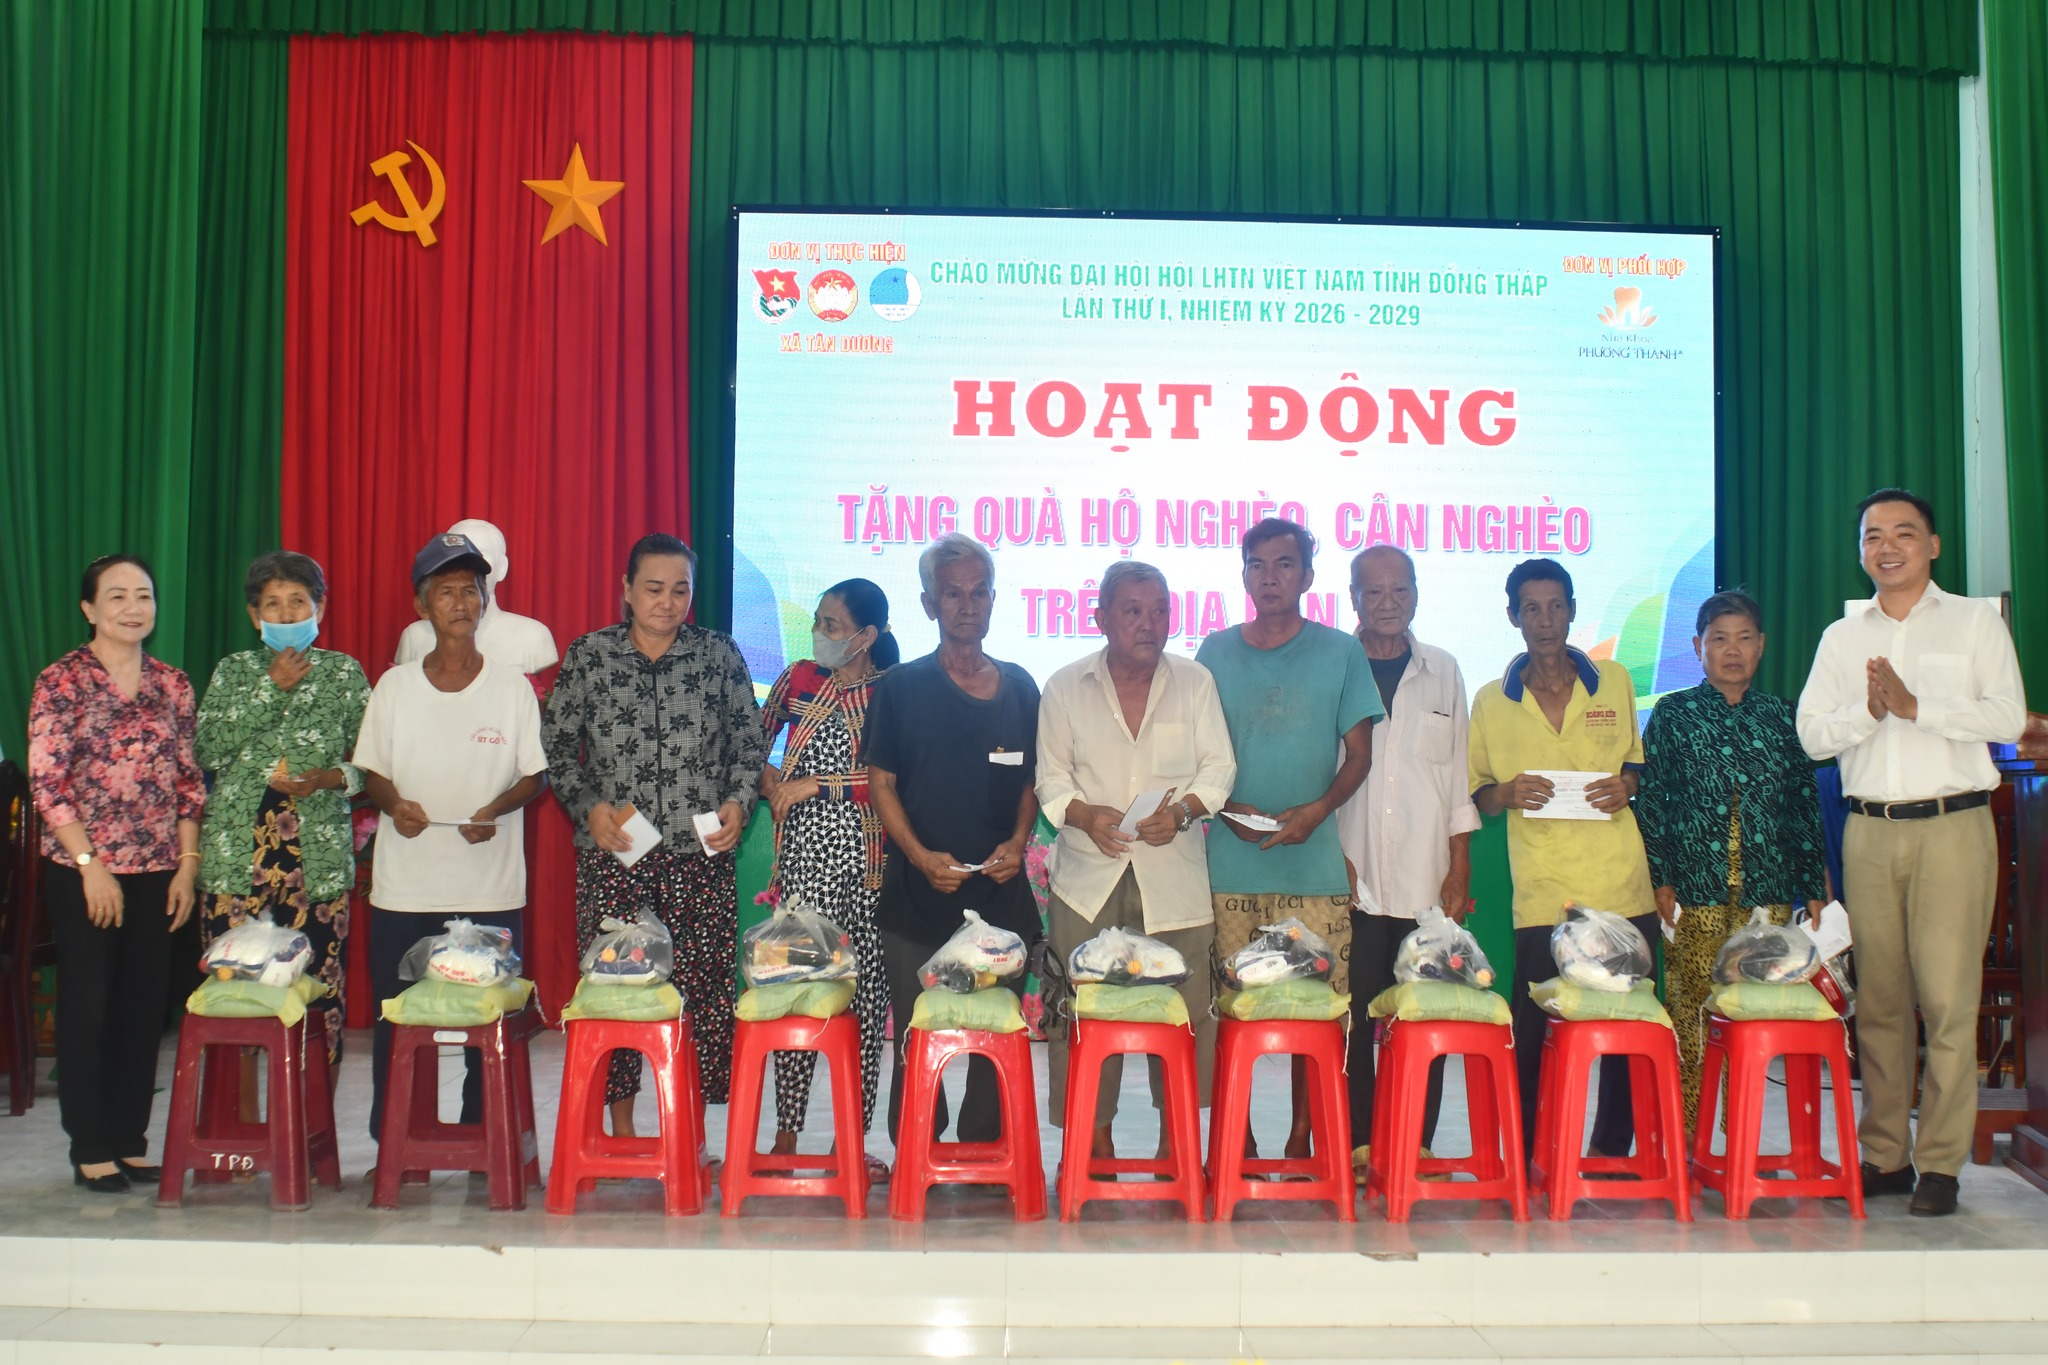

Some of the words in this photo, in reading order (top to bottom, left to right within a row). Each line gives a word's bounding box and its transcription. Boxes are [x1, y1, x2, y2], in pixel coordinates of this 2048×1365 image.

[768, 241, 801, 260] ĐƠN
[806, 243, 820, 264] VỊ
[825, 242, 865, 264] THỰC
[869, 240, 906, 265] HIỆN
[1563, 255, 1595, 273] ĐƠN
[1599, 257, 1613, 277] VỊ
[1617, 253, 1653, 275] PHỐI
[1656, 257, 1687, 279] HỢP
[930, 256, 988, 284] CHÀO
[997, 257, 1062, 285] MỪNG
[1114, 260, 1149, 291] HỘI
[1158, 261, 1193, 292] HỘI
[1202, 267, 1254, 289] LHTN
[1262, 263, 1307, 294] VIỆT
[1315, 269, 1364, 292] NAM
[1495, 269, 1548, 296] THÁP
[1160, 299, 1172, 322] I,
[1180, 295, 1251, 326] NHIỆM
[1294, 302, 1345, 324] 2026
[1369, 303, 1420, 326] 2029
[780, 332, 802, 352] XÃ
[806, 332, 836, 352] TÂN
[841, 333, 893, 353] DƯƠNG
[953, 380, 1212, 453] HOẠT
[1247, 372, 1517, 457] ĐỘNG
[837, 484, 957, 553] TẶNG
[972, 486, 1066, 551] QUÀ
[1080, 487, 1140, 556] HỘ
[1442, 495, 1591, 554] NGHÈO
[1020, 579, 1100, 637] TRÊ
